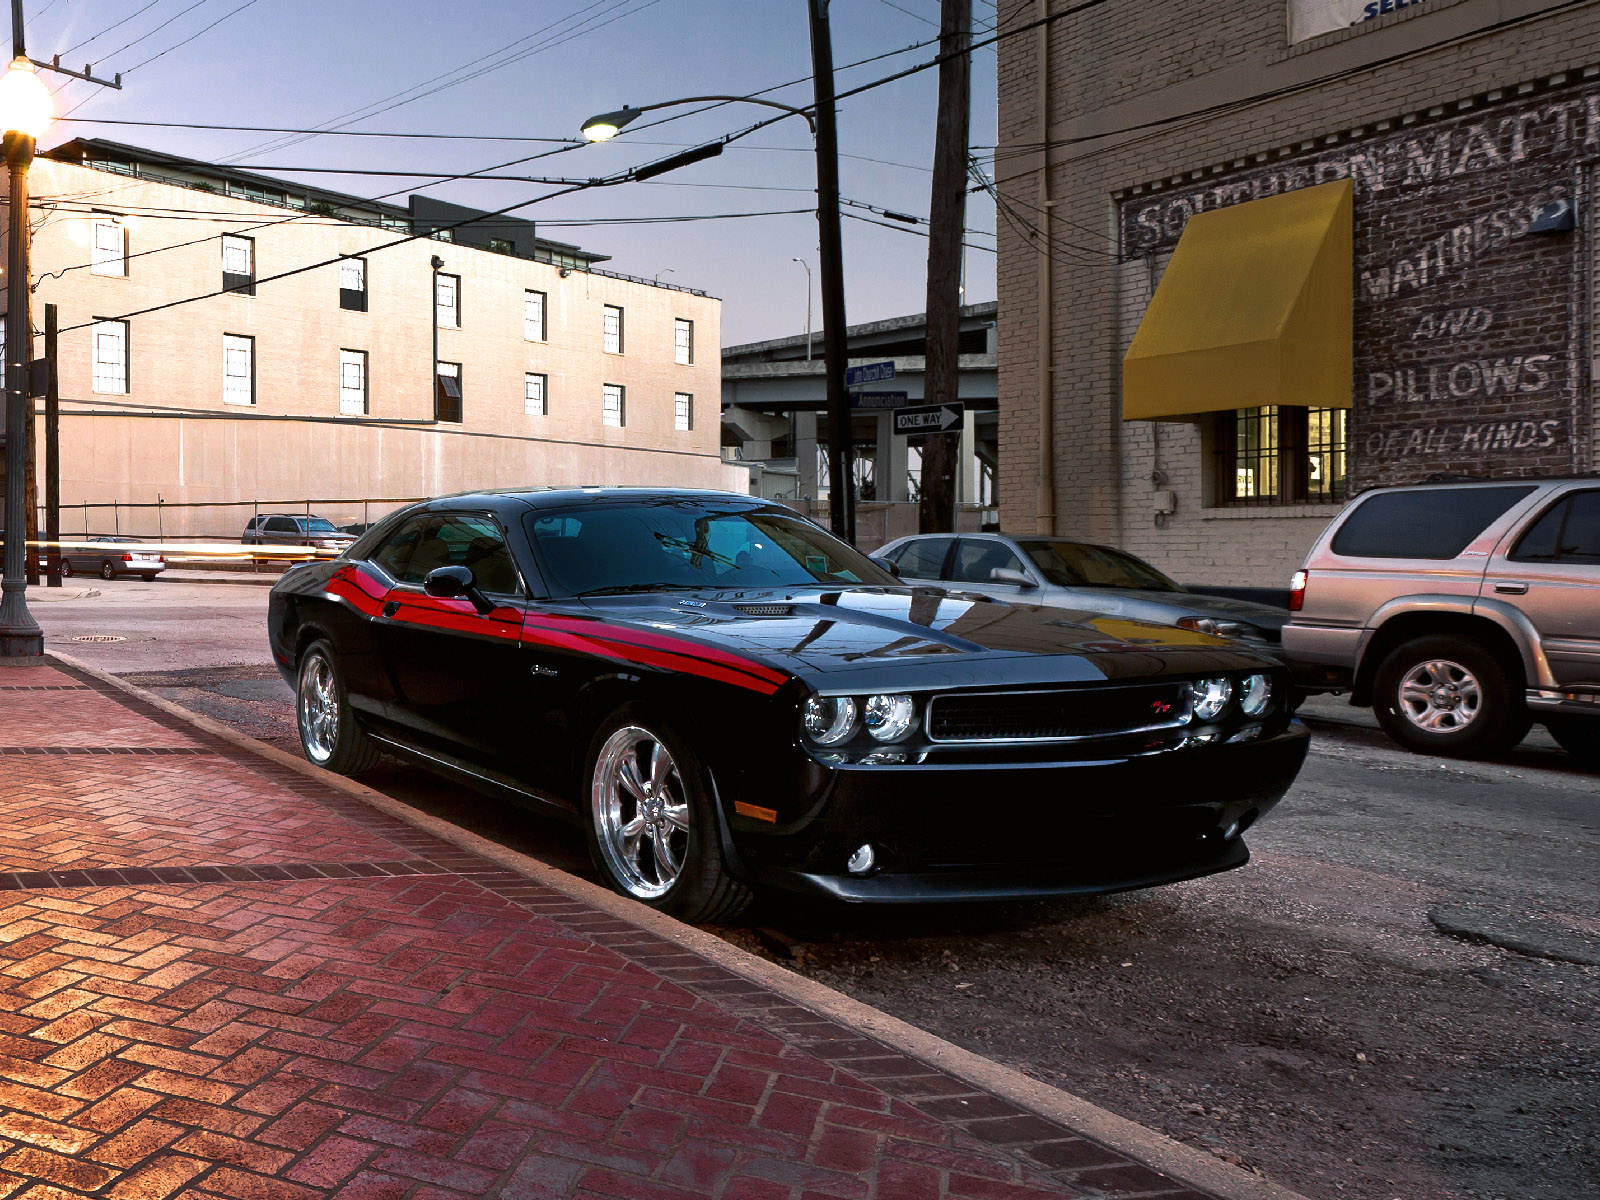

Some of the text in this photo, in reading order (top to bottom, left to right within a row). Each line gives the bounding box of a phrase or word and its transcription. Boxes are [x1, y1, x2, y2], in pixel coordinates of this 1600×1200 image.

[1364, 0, 1419, 20] SEL
[1411, 306, 1494, 341] AND
[1367, 354, 1557, 405] PILLOWS
[900, 413, 942, 427] ONE WAY
[1366, 419, 1561, 458] OF ALL KINDS
